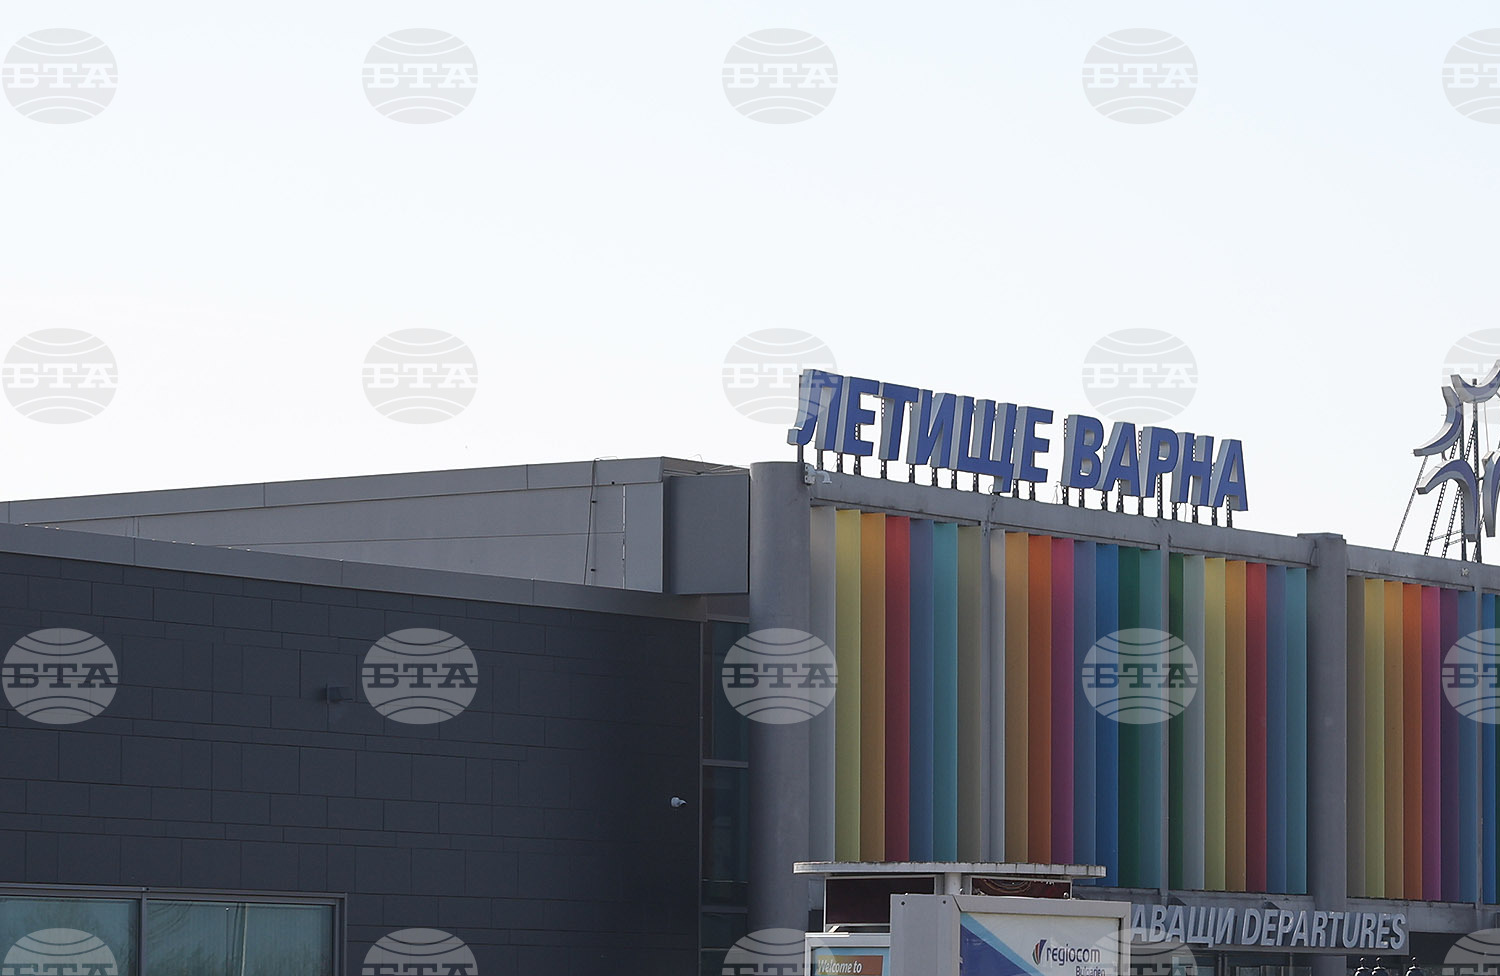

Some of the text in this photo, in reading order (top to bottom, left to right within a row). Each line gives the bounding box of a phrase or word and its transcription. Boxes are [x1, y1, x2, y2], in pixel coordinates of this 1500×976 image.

[787, 369, 1248, 511] ЛЕТИЩЕ ВАРНА
[1130, 904, 1406, 950] АВАЩИ DEPARTURES
[817, 958, 862, 974] Welcome to
[1046, 944, 1100, 966] regiocom
